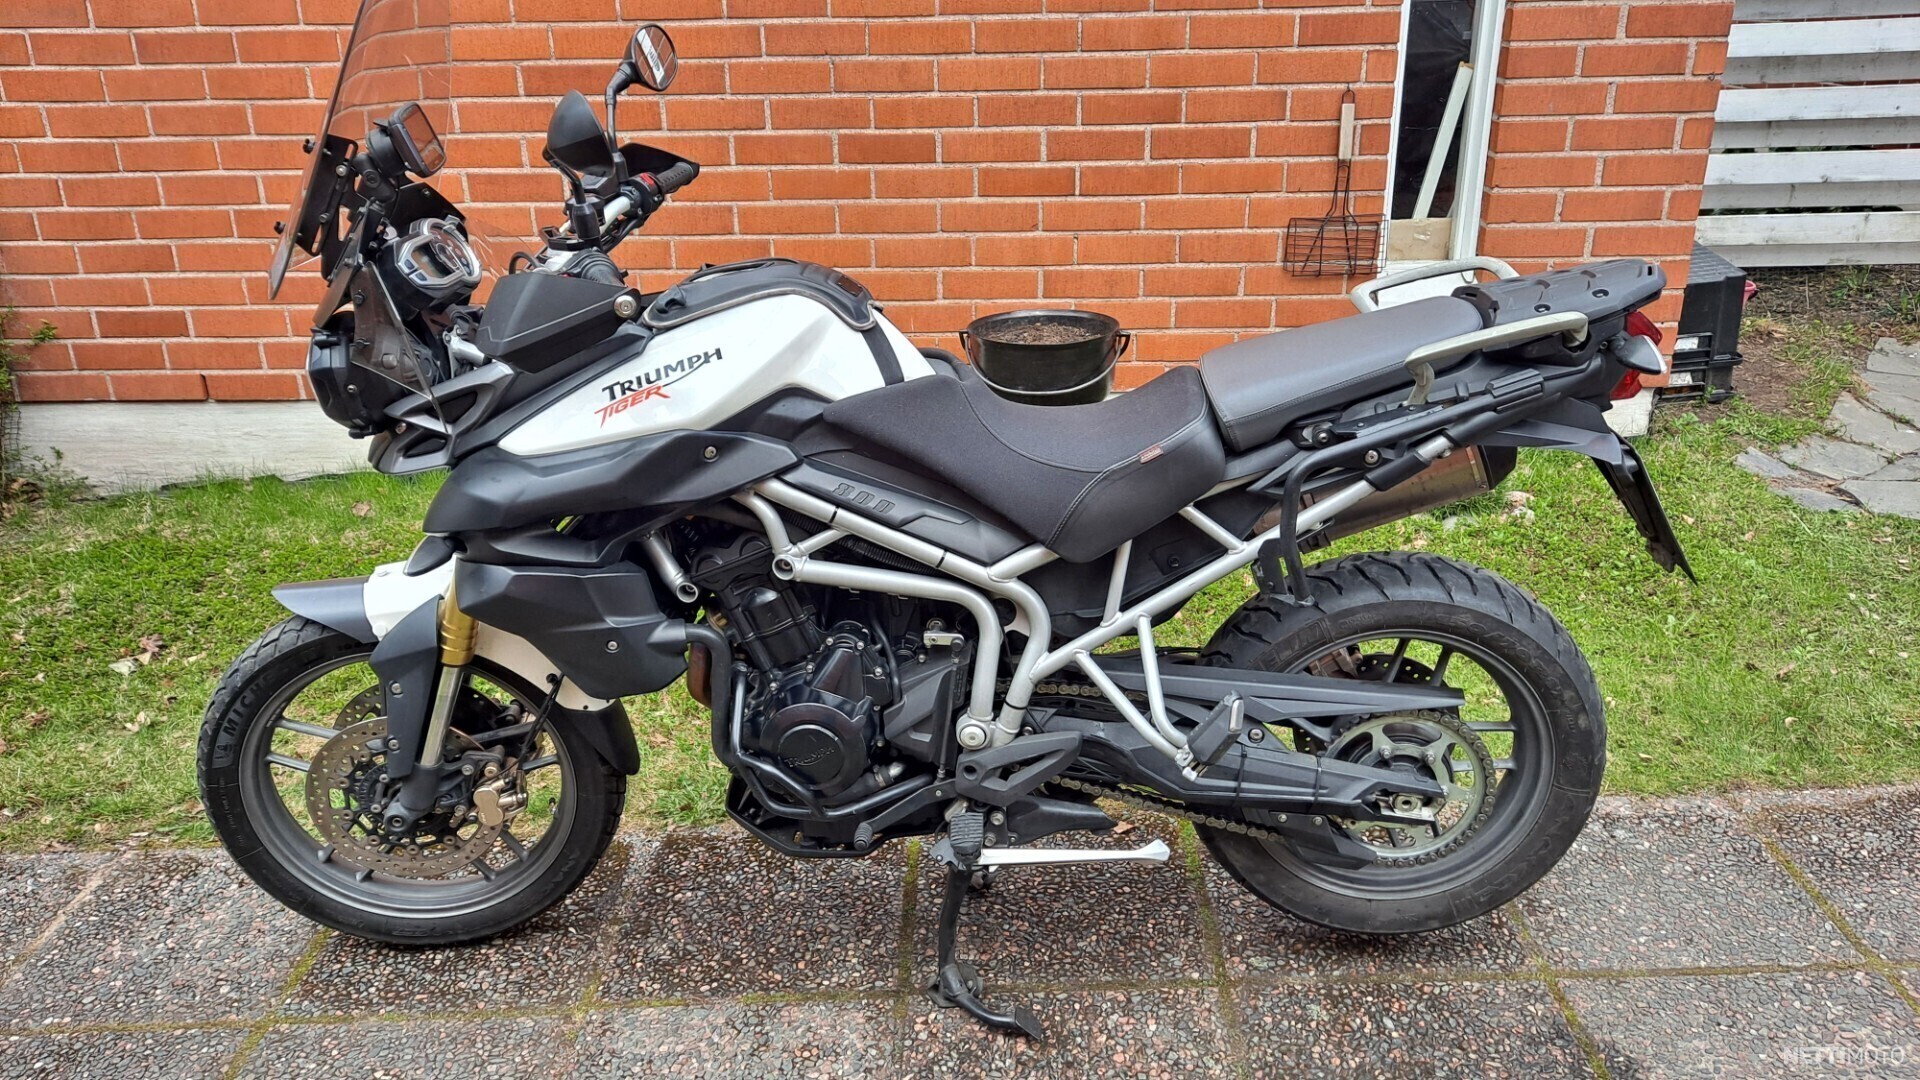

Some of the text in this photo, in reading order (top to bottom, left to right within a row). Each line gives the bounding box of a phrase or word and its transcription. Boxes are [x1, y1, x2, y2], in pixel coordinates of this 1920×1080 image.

[602, 347, 723, 402] TRIUMPH
[594, 383, 671, 428] TIGER
[832, 482, 896, 514] 800
